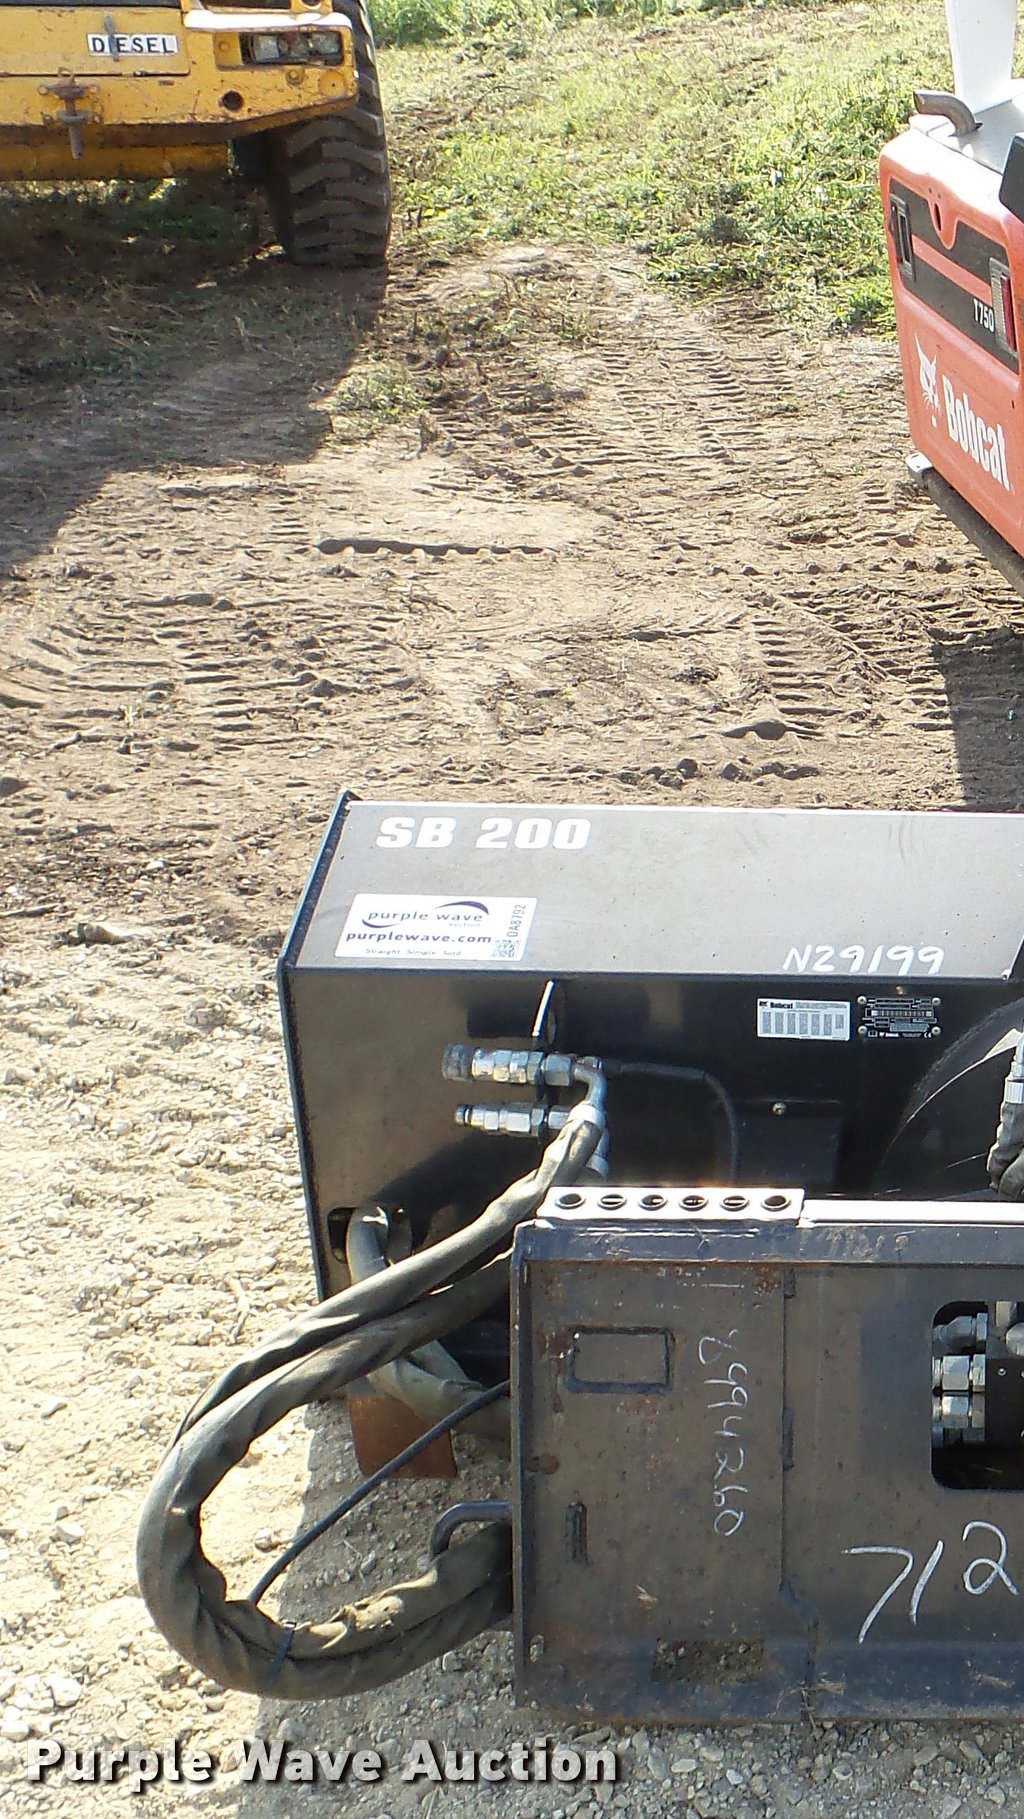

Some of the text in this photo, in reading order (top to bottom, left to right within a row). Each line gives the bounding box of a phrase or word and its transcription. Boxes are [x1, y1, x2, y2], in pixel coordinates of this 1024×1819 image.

[92, 37, 174, 53] DESEL
[973, 299, 995, 332] T750
[942, 374, 1010, 491] Bobcat
[376, 817, 591, 849] SB 200
[367, 911, 483, 922] purple wave
[346, 931, 492, 943] purplewave.com
[782, 944, 944, 976] N29199
